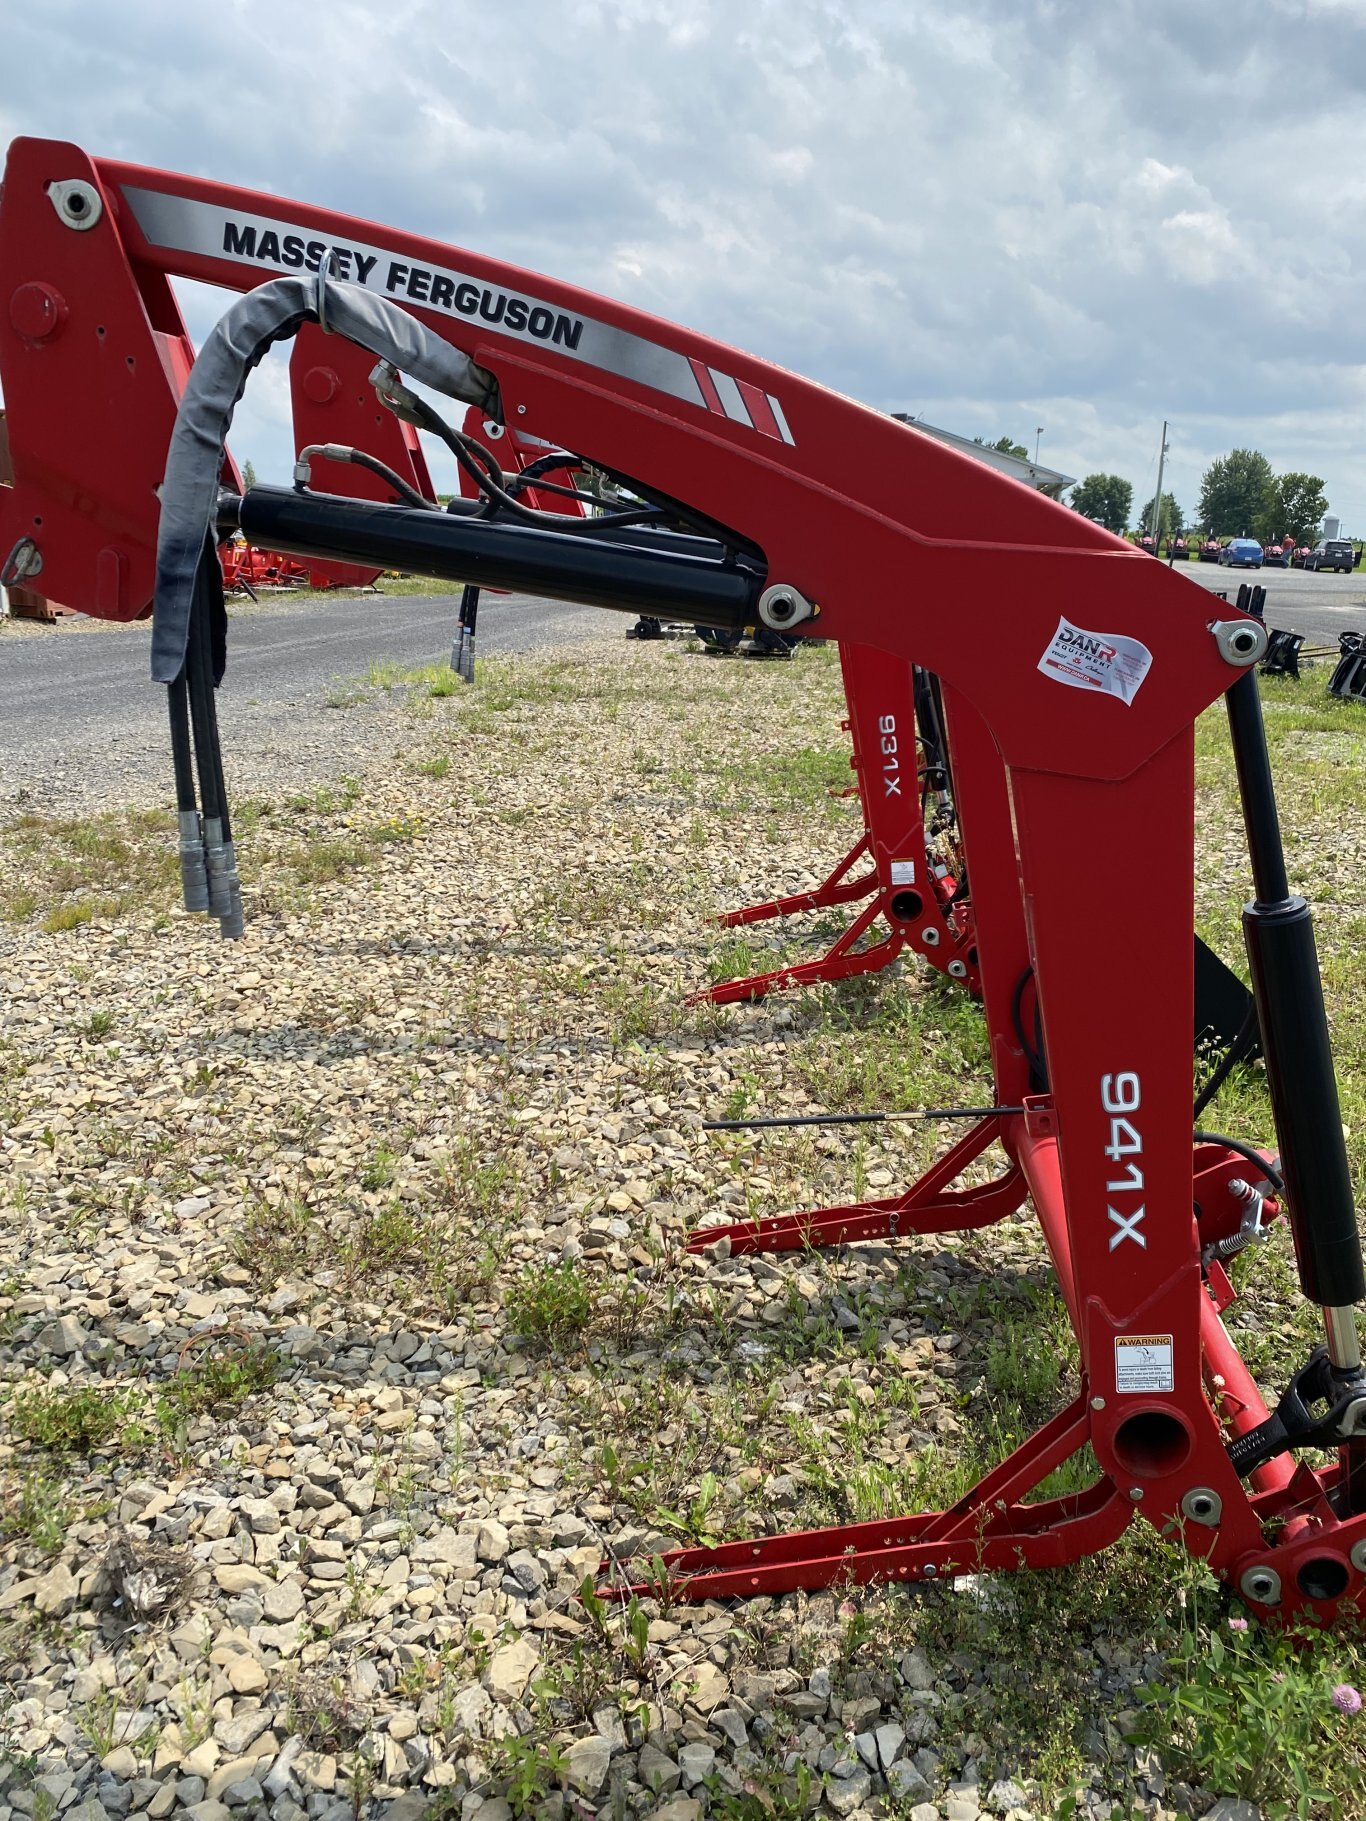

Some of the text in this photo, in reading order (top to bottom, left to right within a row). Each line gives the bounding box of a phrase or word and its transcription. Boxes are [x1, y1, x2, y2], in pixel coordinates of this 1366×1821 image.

[223, 222, 583, 350] MASSEY FERGUSON
[1055, 641, 1111, 669] EQUIPMENT
[879, 715, 901, 797] 931X
[1100, 1070, 1147, 1253] 941X
